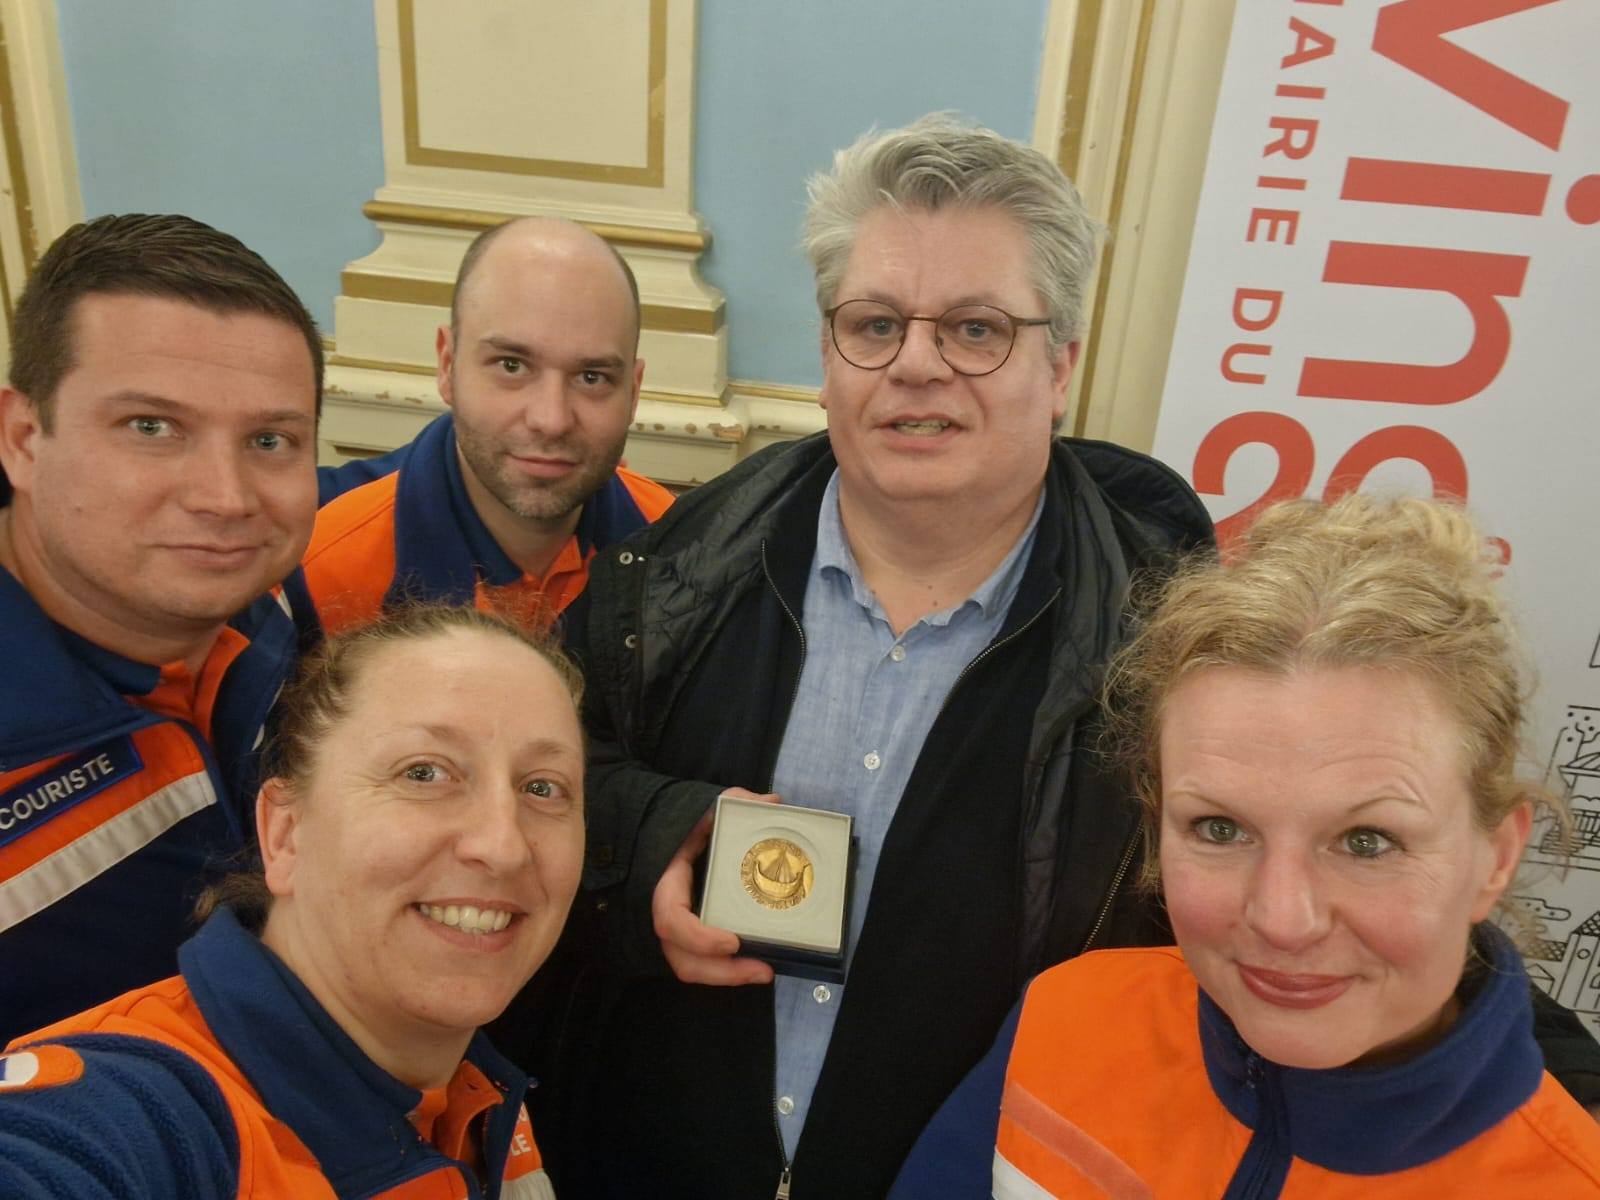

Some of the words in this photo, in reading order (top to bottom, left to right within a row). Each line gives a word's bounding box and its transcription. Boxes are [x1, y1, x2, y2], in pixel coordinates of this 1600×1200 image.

[1246, 0, 1344, 246] AIRIE
[1220, 287, 1284, 385] DU
[0, 752, 115, 830] COURISTE
